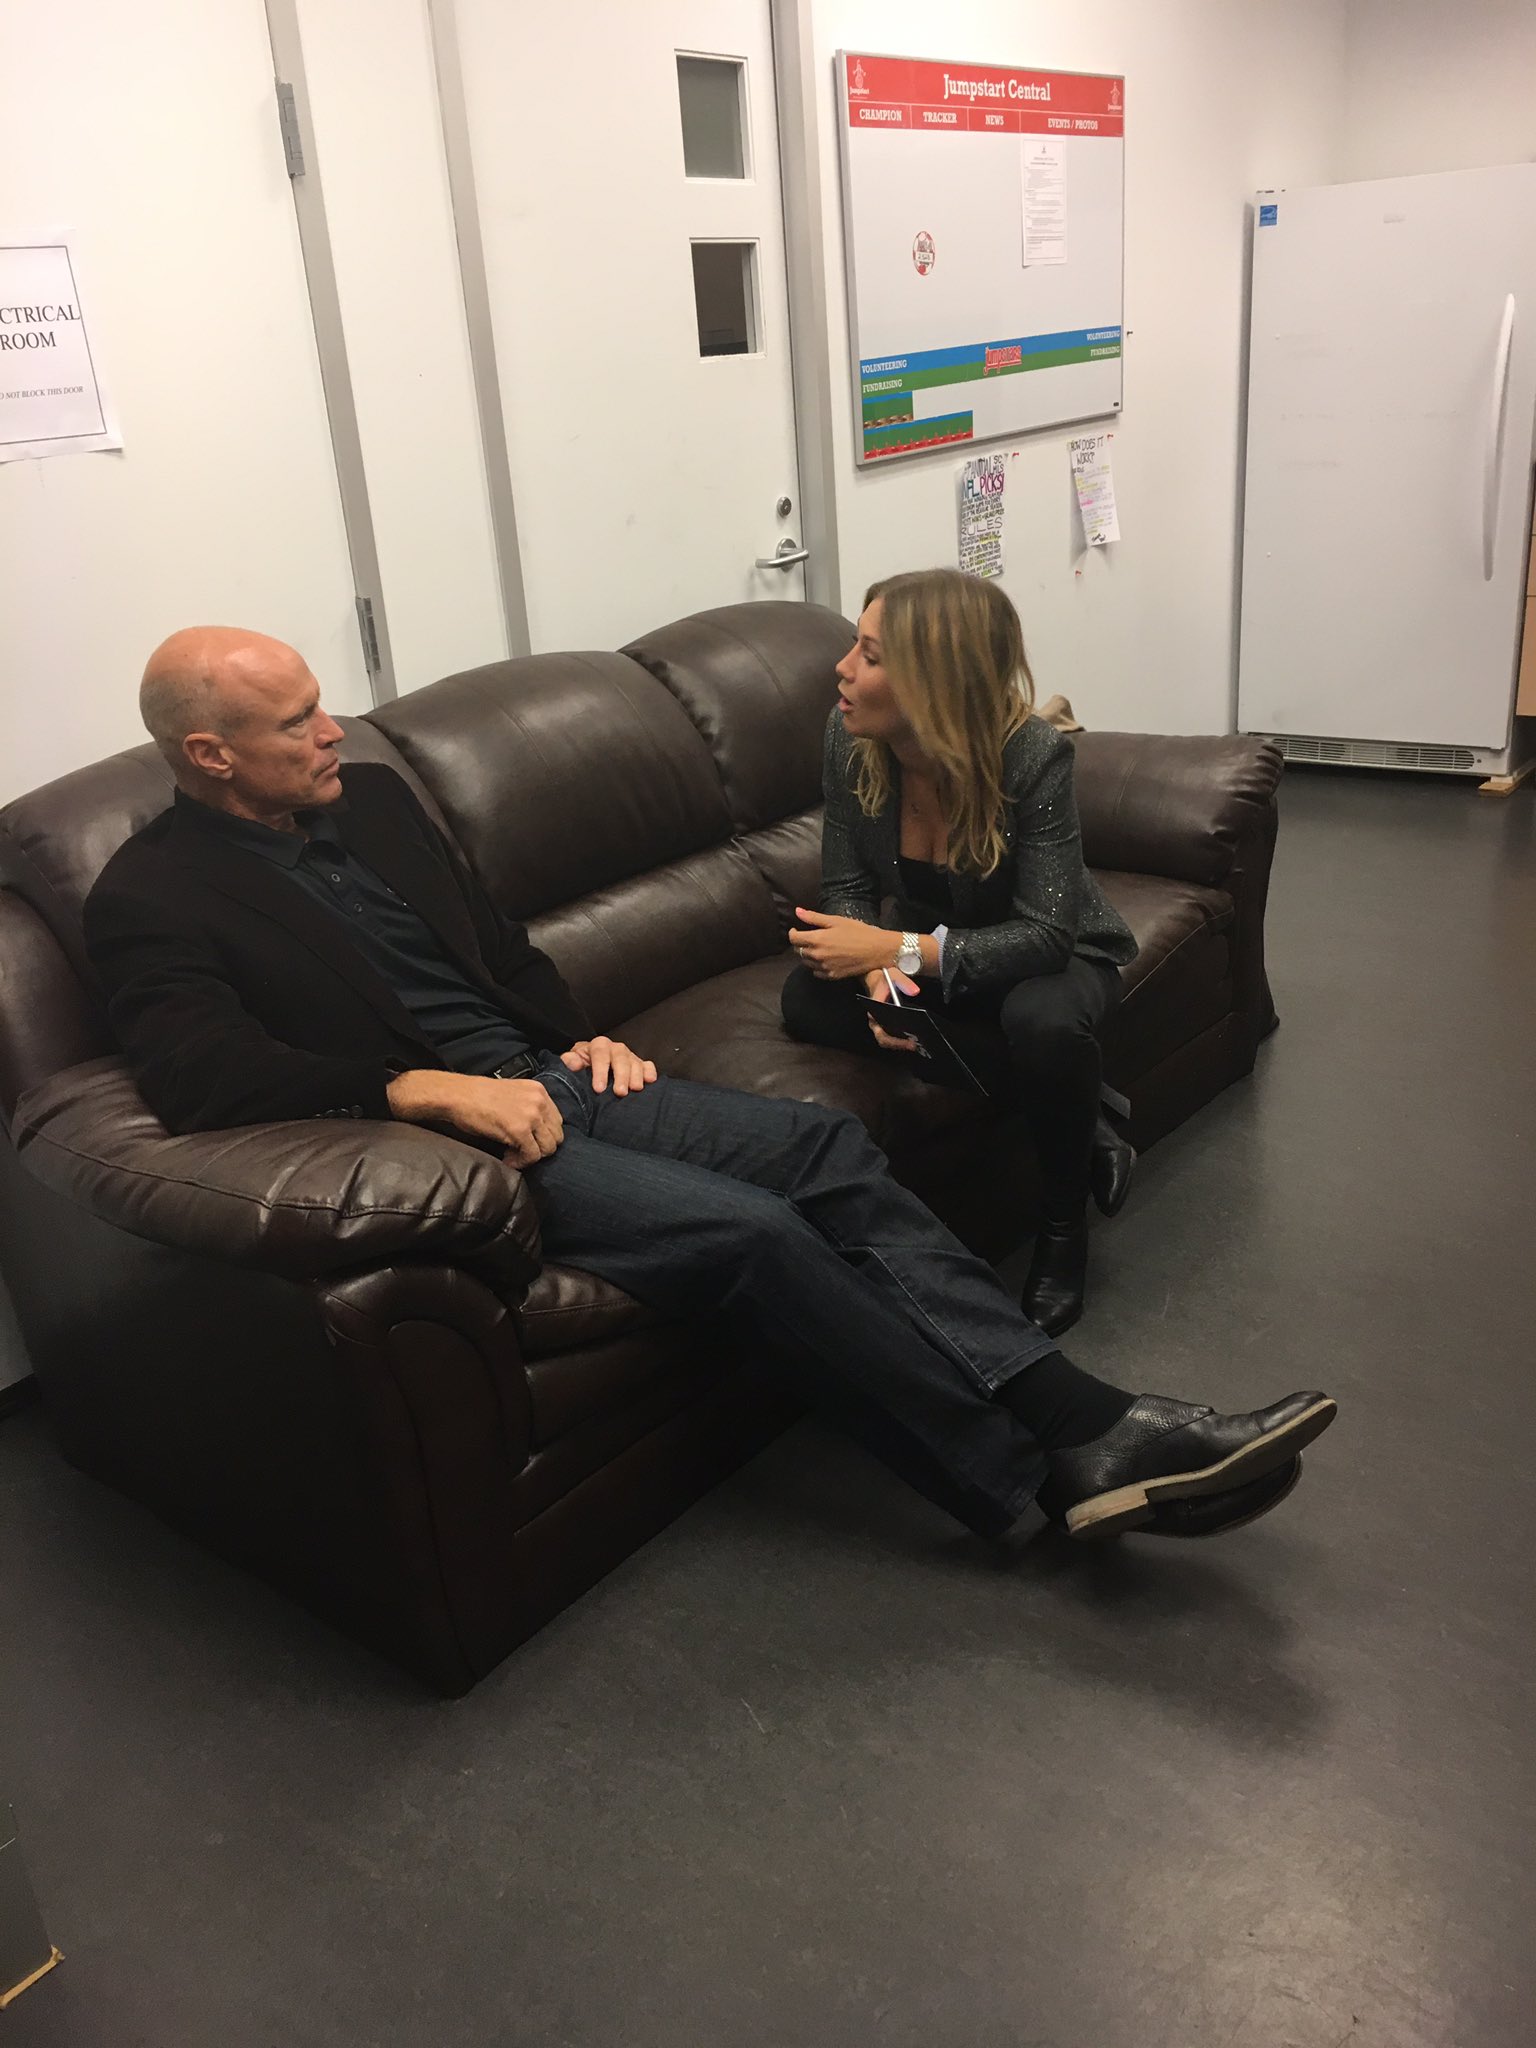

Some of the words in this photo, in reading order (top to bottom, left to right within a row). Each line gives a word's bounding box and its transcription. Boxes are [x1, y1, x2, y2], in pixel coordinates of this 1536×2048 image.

[944, 74, 1005, 101] Jumpstart
[1008, 79, 1051, 101] Central
[859, 109, 902, 122] CHAMPION
[923, 112, 957, 123] TRACKER
[985, 115, 1004, 126] NEWS
[1048, 118, 1071, 129] EVENTS
[1075, 120, 1098, 130] PHOTOS
[0, 304, 81, 325] CTRICAL
[0, 331, 56, 350] ROOM
[862, 359, 908, 374] VOLUNTEERING
[6, 391, 20, 399] NOT
[22, 389, 45, 398] BLOCK
[47, 388, 62, 396] THIS
[63, 386, 84, 395] DOOR
[863, 379, 902, 393] FUNDRAISING
[961, 516, 1003, 536] RULES
